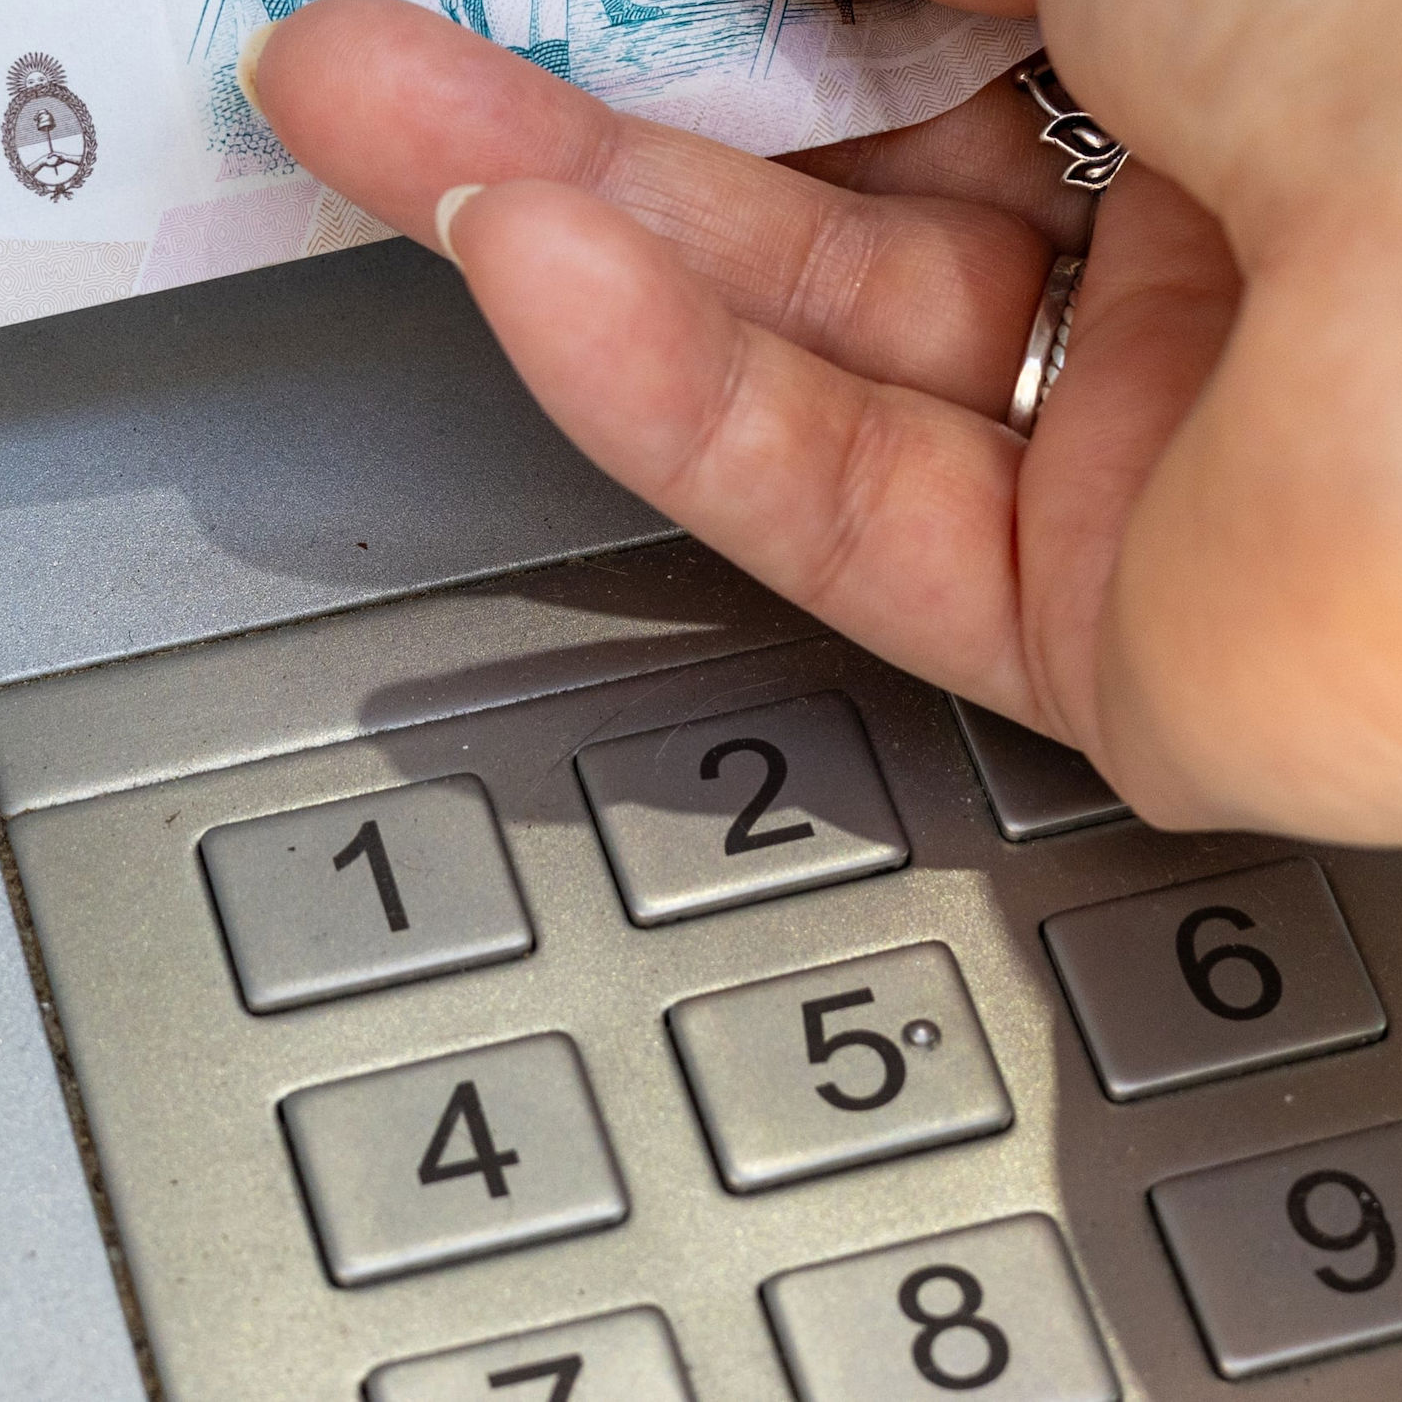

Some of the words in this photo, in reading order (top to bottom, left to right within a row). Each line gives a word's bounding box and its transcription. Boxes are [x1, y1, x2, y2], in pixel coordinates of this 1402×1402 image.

[698, 736, 816, 857] 2
[331, 818, 411, 934] 1
[1174, 904, 1284, 1022] 6
[800, 987, 907, 1112] 5
[416, 1080, 520, 1200] 4
[1284, 1168, 1398, 1295] 9
[897, 1263, 1011, 1393] 8
